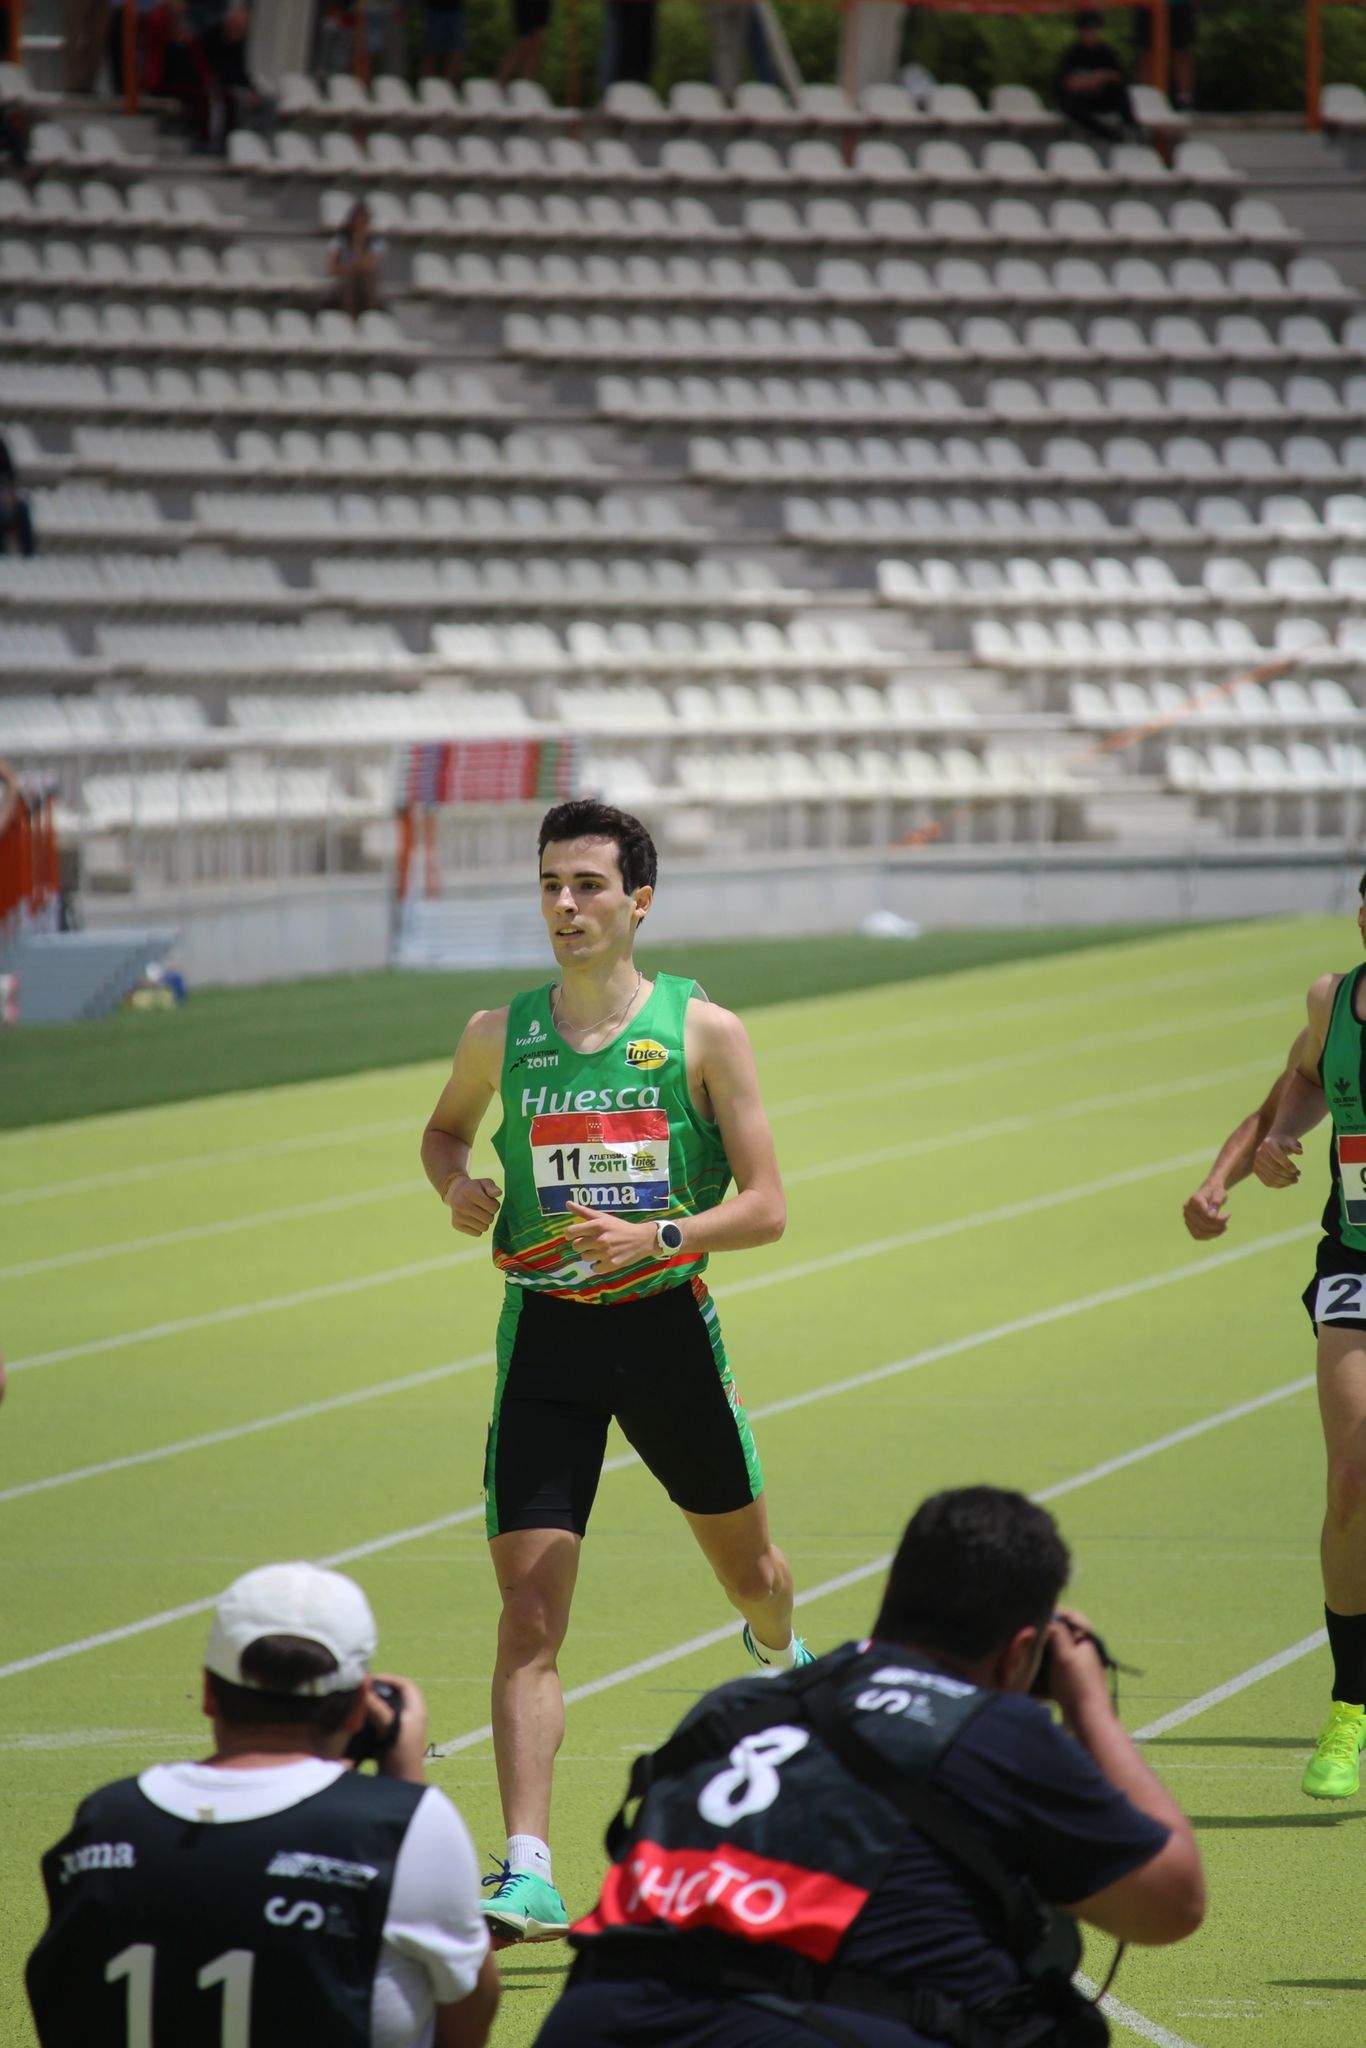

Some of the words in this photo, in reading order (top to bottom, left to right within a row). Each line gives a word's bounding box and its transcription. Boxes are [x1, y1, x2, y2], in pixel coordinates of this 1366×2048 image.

[516, 1033, 547, 1046] VIATOR
[527, 1055, 558, 1069] ZOITI
[521, 1086, 660, 1117] Huesca
[549, 1147, 580, 1182] 11
[589, 1160, 627, 1173] ZOITI
[1324, 1278, 1362, 1315] 2
[698, 1724, 810, 1828] 8
[105, 1942, 256, 2048] 11
